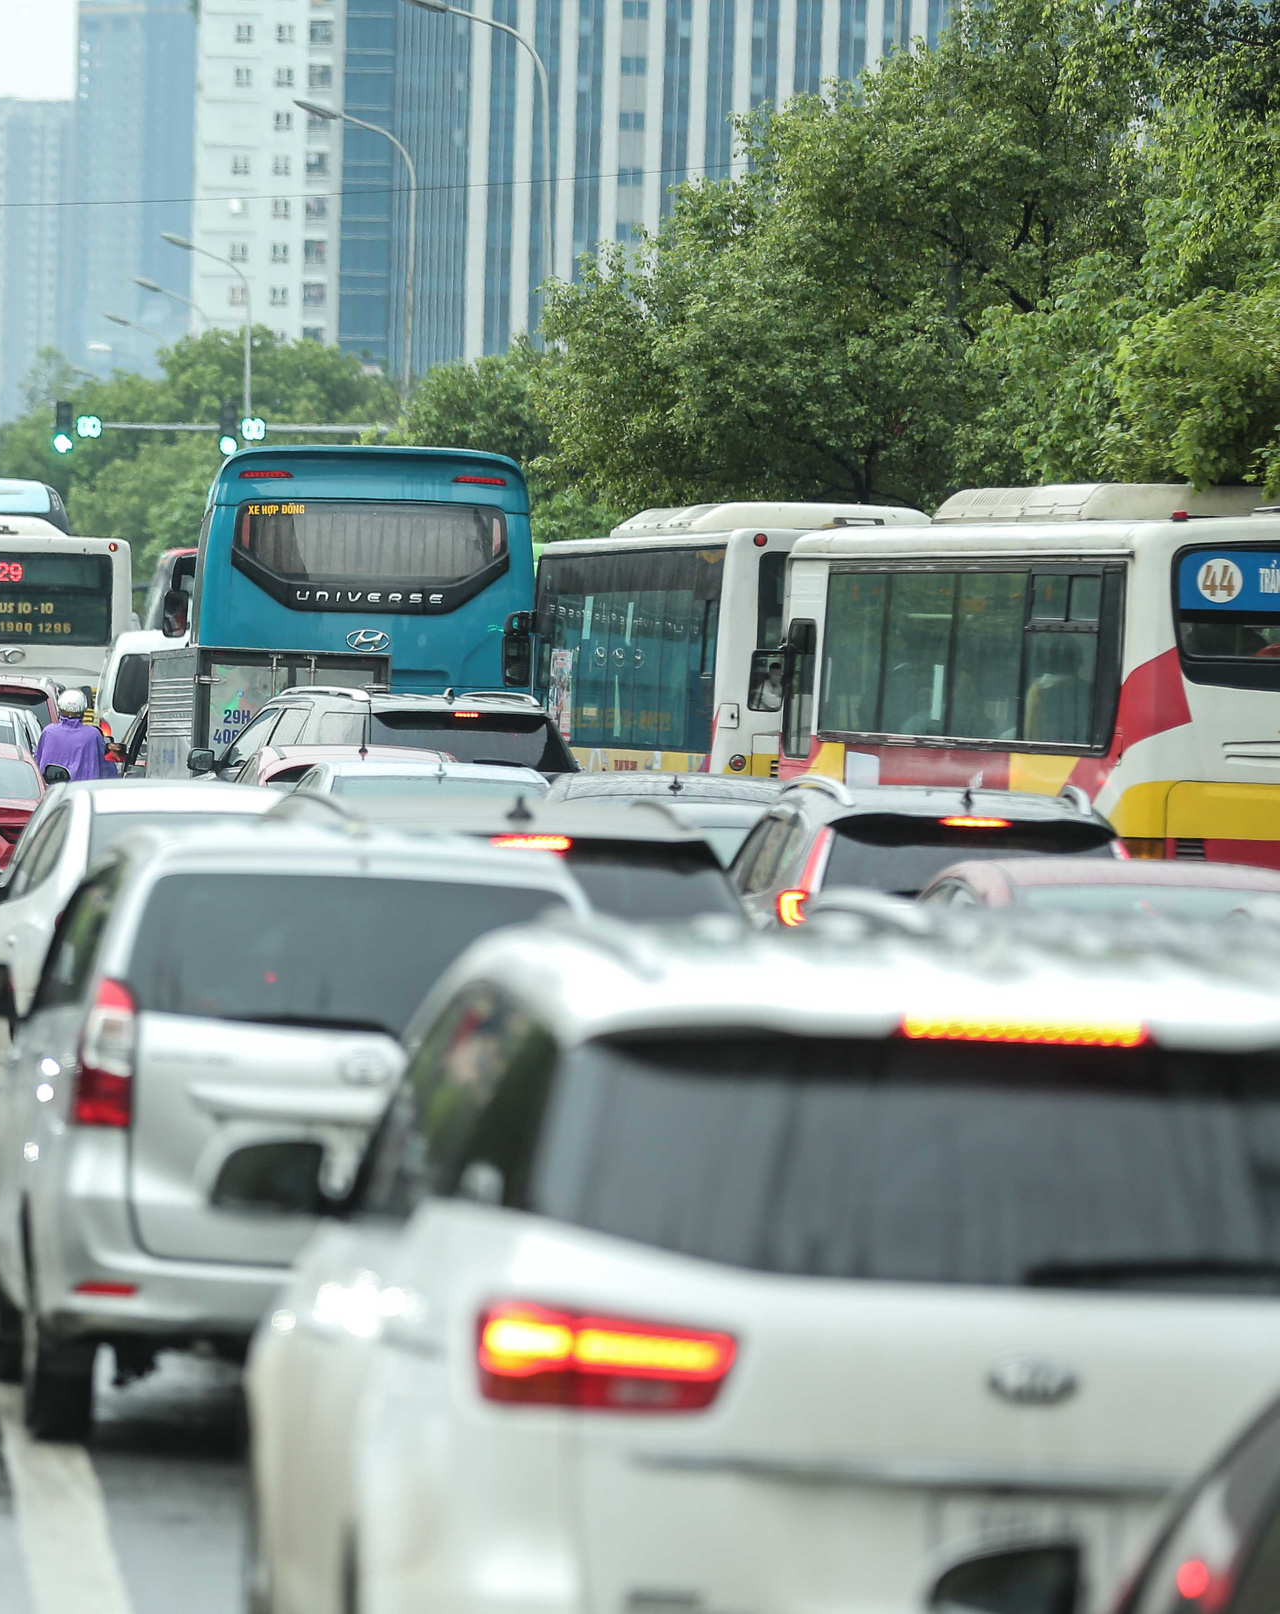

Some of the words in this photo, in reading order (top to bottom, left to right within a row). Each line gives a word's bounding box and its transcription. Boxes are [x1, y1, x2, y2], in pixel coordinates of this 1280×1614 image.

[248, 505, 260, 515] XE
[1202, 564, 1236, 597] 44
[296, 590, 444, 604] UNIVERSE
[223, 709, 251, 725] 29H
